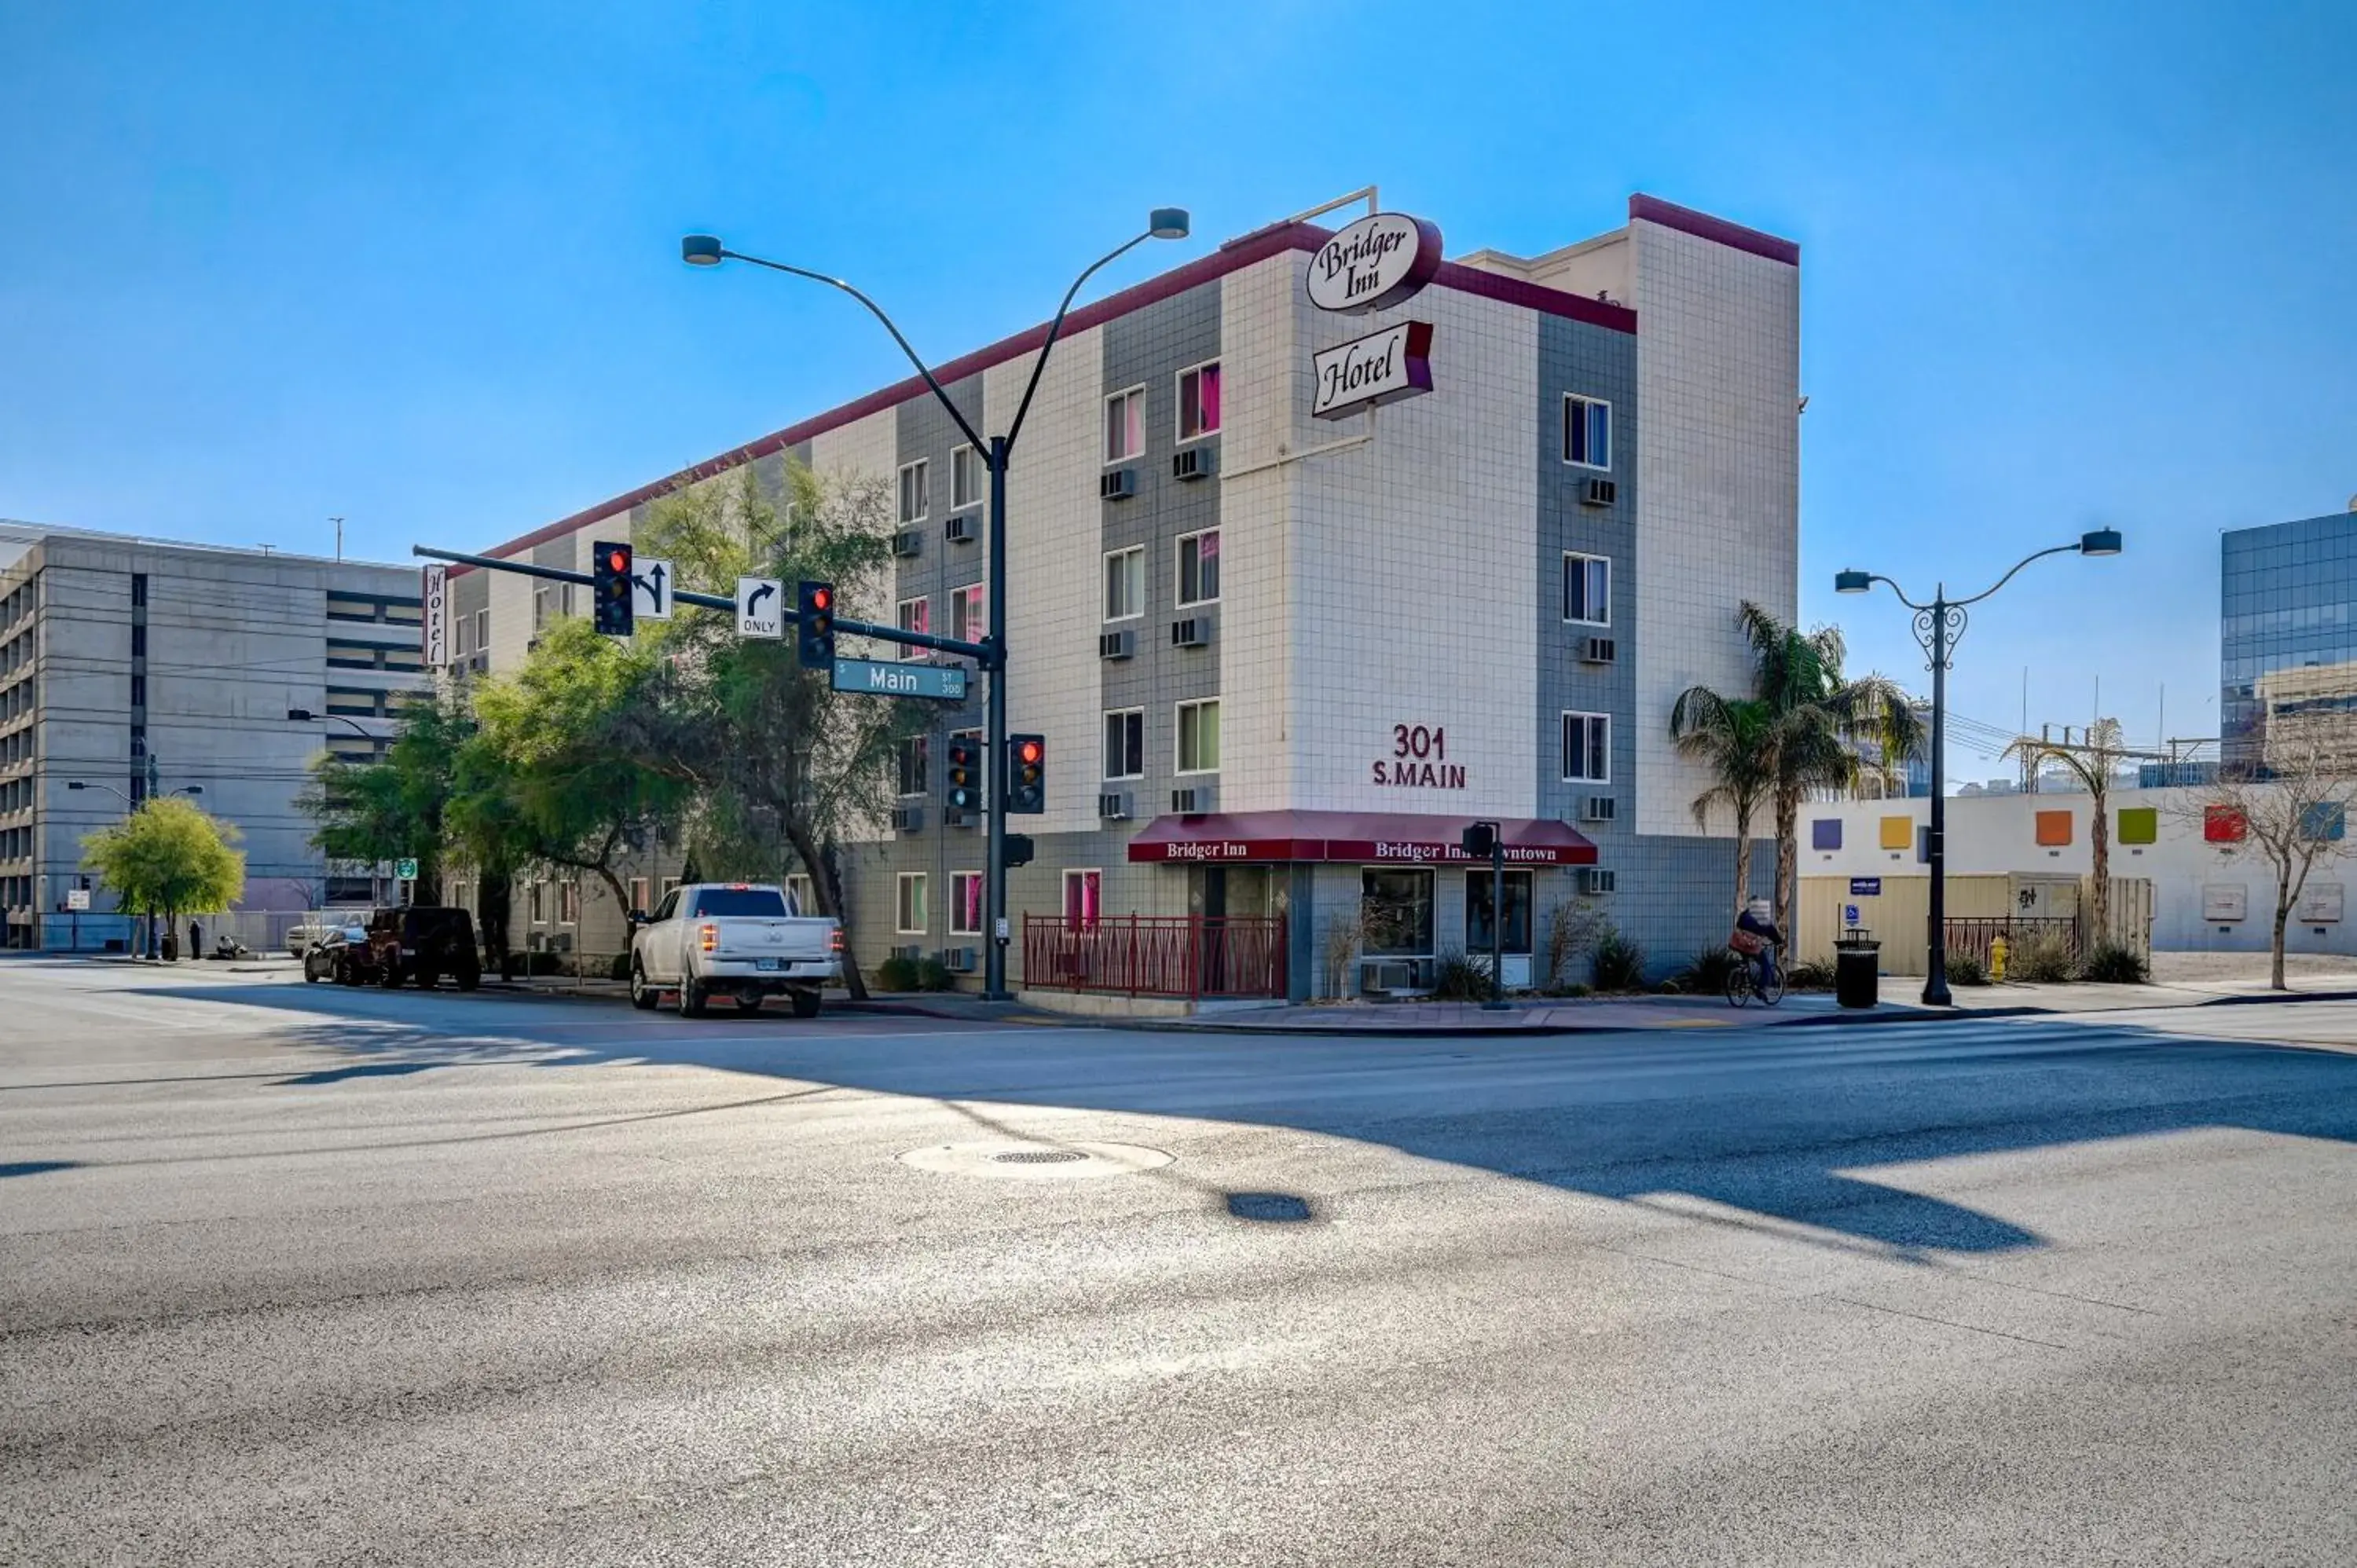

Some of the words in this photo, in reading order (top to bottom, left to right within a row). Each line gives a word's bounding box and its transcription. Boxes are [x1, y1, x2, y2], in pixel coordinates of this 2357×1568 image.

[1318, 222, 1407, 282] Bridger
[1344, 265, 1380, 299] Inn
[1321, 335, 1399, 406] Hotel
[428, 570, 444, 662] Hotel
[744, 619, 775, 632] ONLY
[870, 667, 917, 691] Main
[1393, 724, 1444, 760] 301
[1373, 760, 1466, 789] S.MAIN
[1168, 842, 1220, 861] Bridger
[1223, 841, 1247, 855] Inn
[1376, 842, 1440, 861] Bridger
